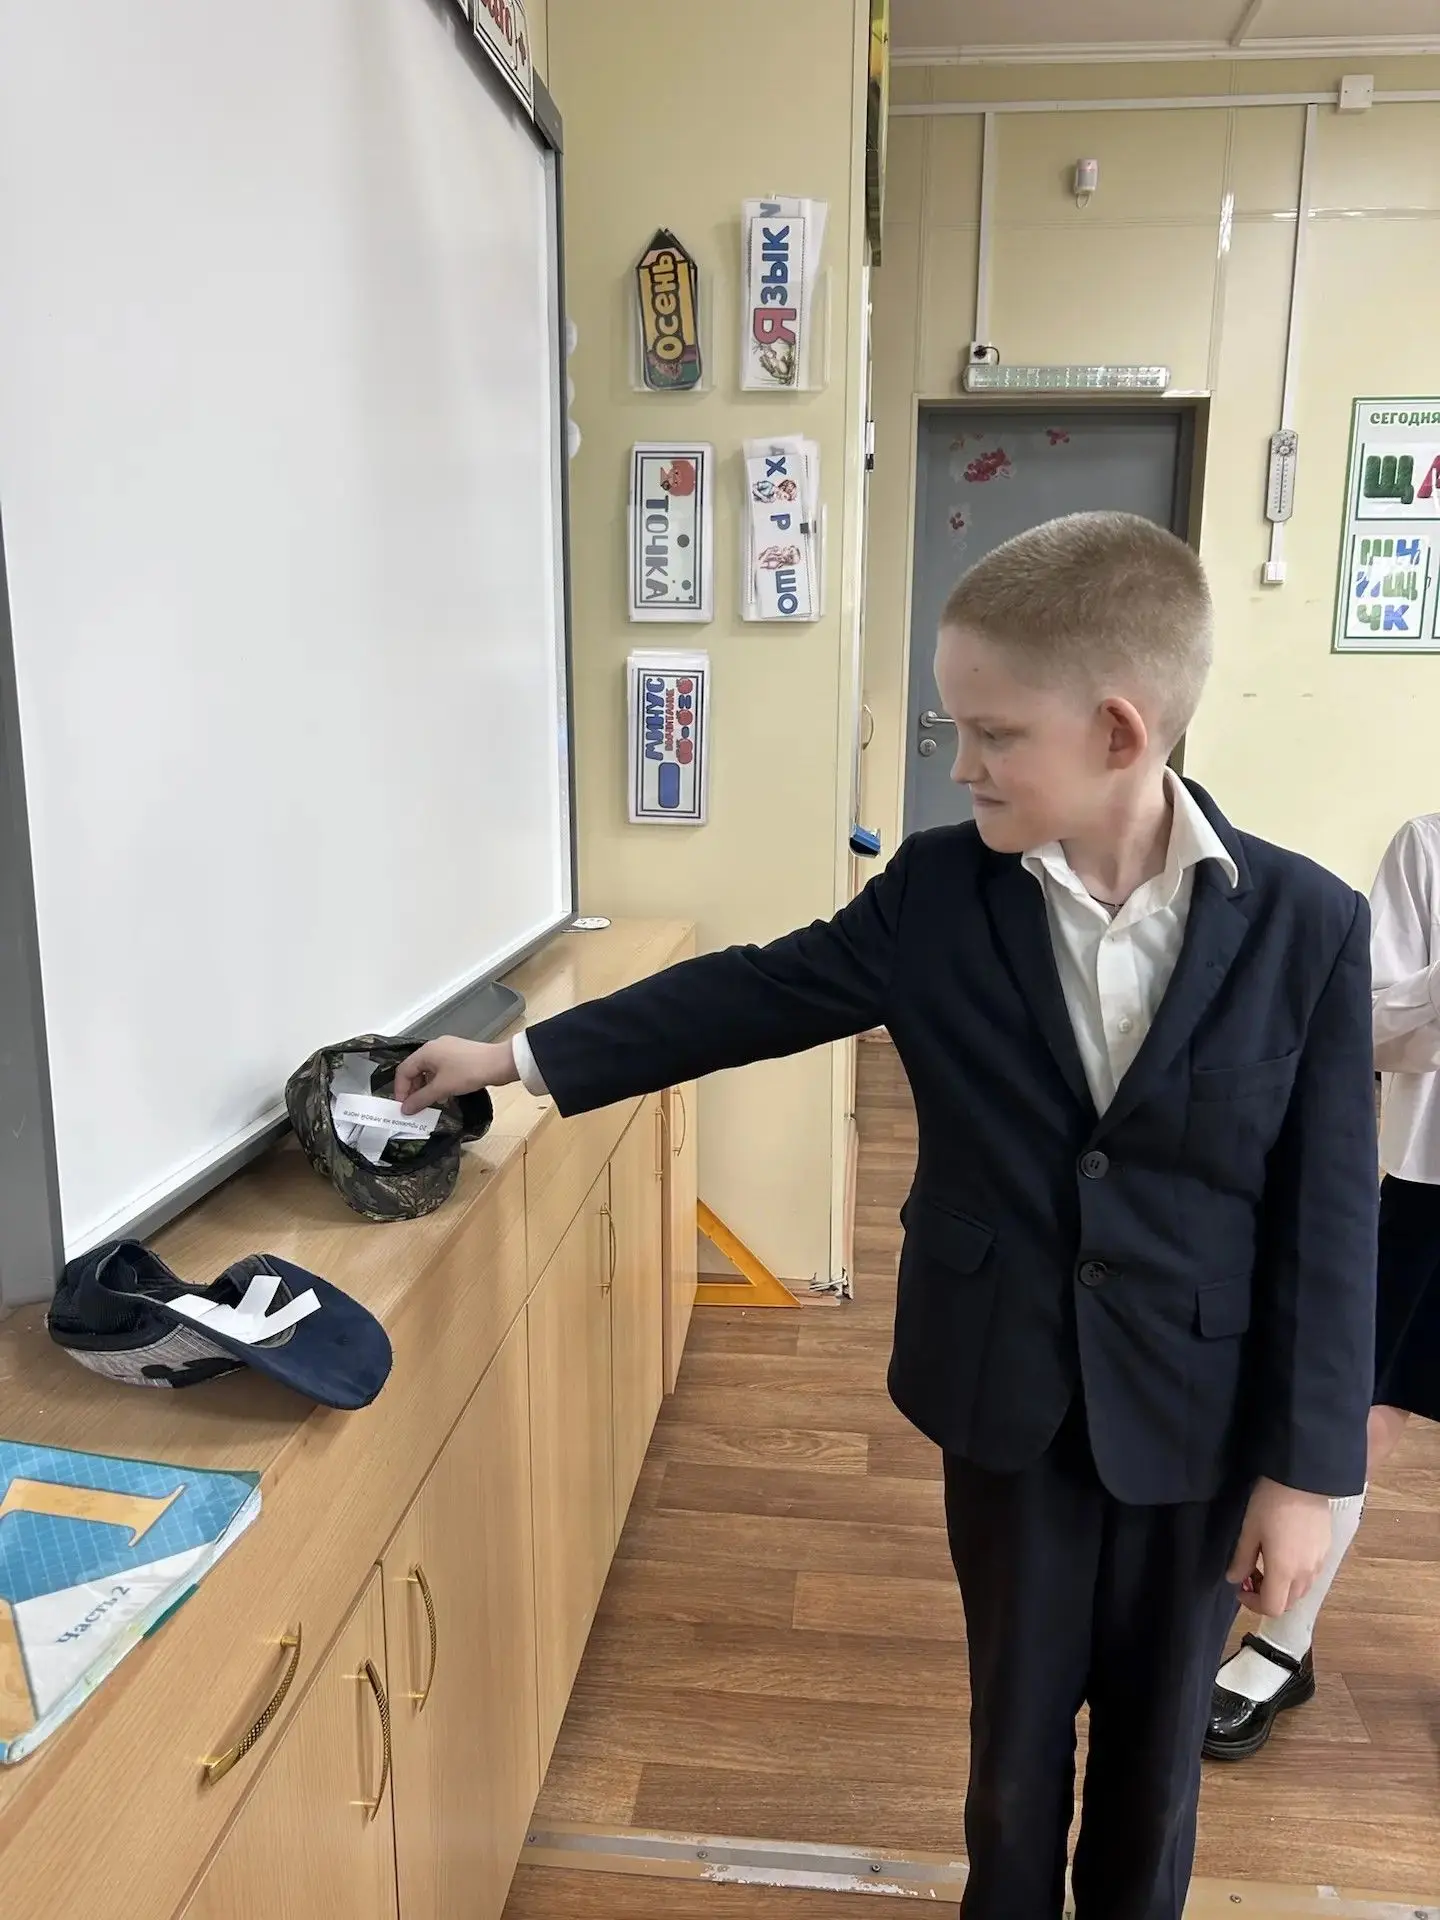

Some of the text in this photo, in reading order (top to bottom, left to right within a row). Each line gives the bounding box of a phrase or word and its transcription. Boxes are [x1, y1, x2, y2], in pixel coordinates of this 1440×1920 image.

[753, 225, 797, 345] ЯЗЫК
[645, 495, 669, 600] ТОЧКА
[644, 677, 665, 761] МИНУС
[361, 1113, 382, 1122] левой
[111, 1586, 130, 1595] 2
